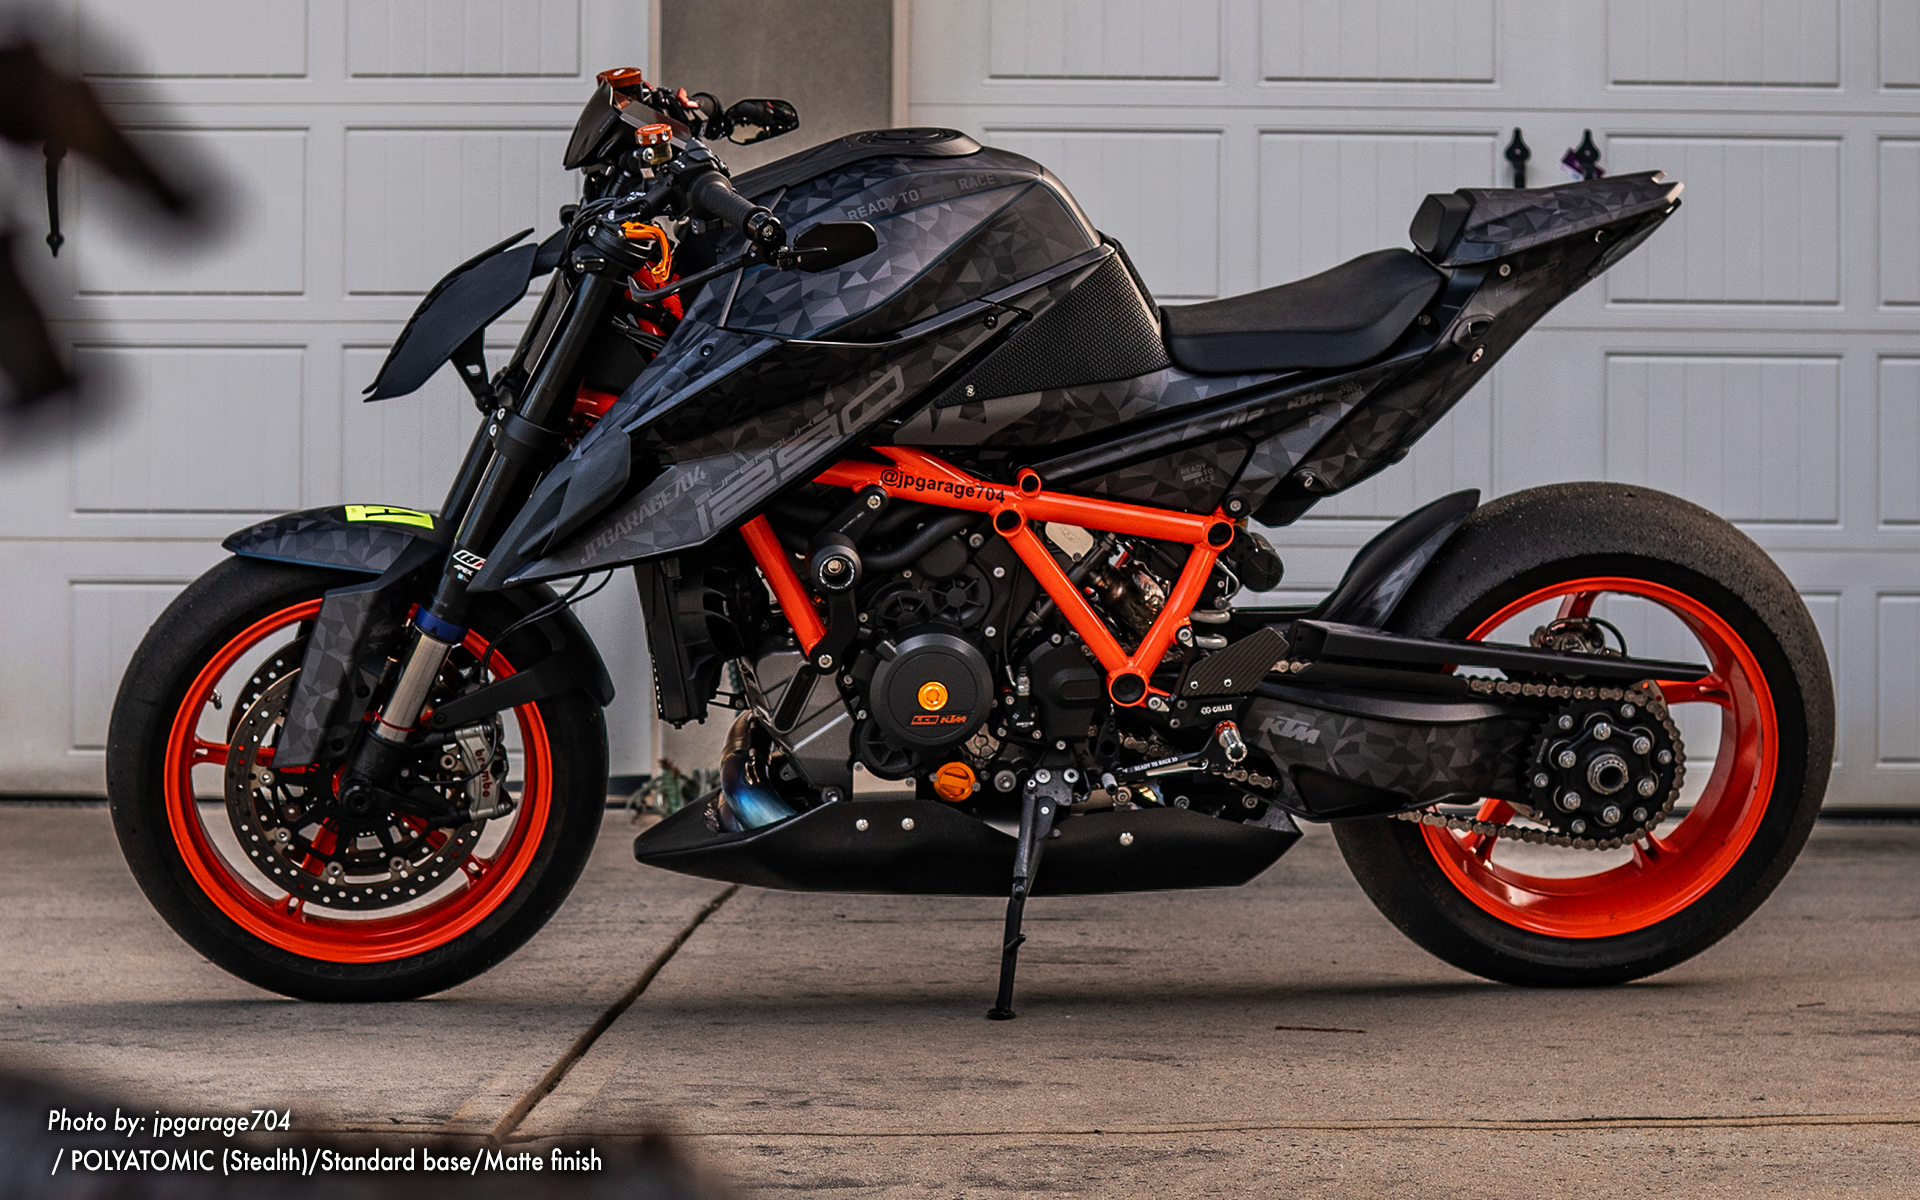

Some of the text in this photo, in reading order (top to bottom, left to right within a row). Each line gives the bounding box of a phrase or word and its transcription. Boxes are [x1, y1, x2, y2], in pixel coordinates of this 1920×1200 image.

[847, 173, 996, 221] READY TO RACE
[1287, 393, 1324, 410] KTM
[695, 365, 906, 536] 1290
[1181, 463, 1206, 475] READY
[880, 468, 1005, 503] @jpgarage704
[1194, 474, 1215, 485] RACE
[1212, 703, 1233, 713] GILLES
[940, 714, 967, 724] KTM
[1259, 715, 1321, 744] KTM
[1134, 763, 1151, 772] READY
[1159, 758, 1171, 767] RACE
